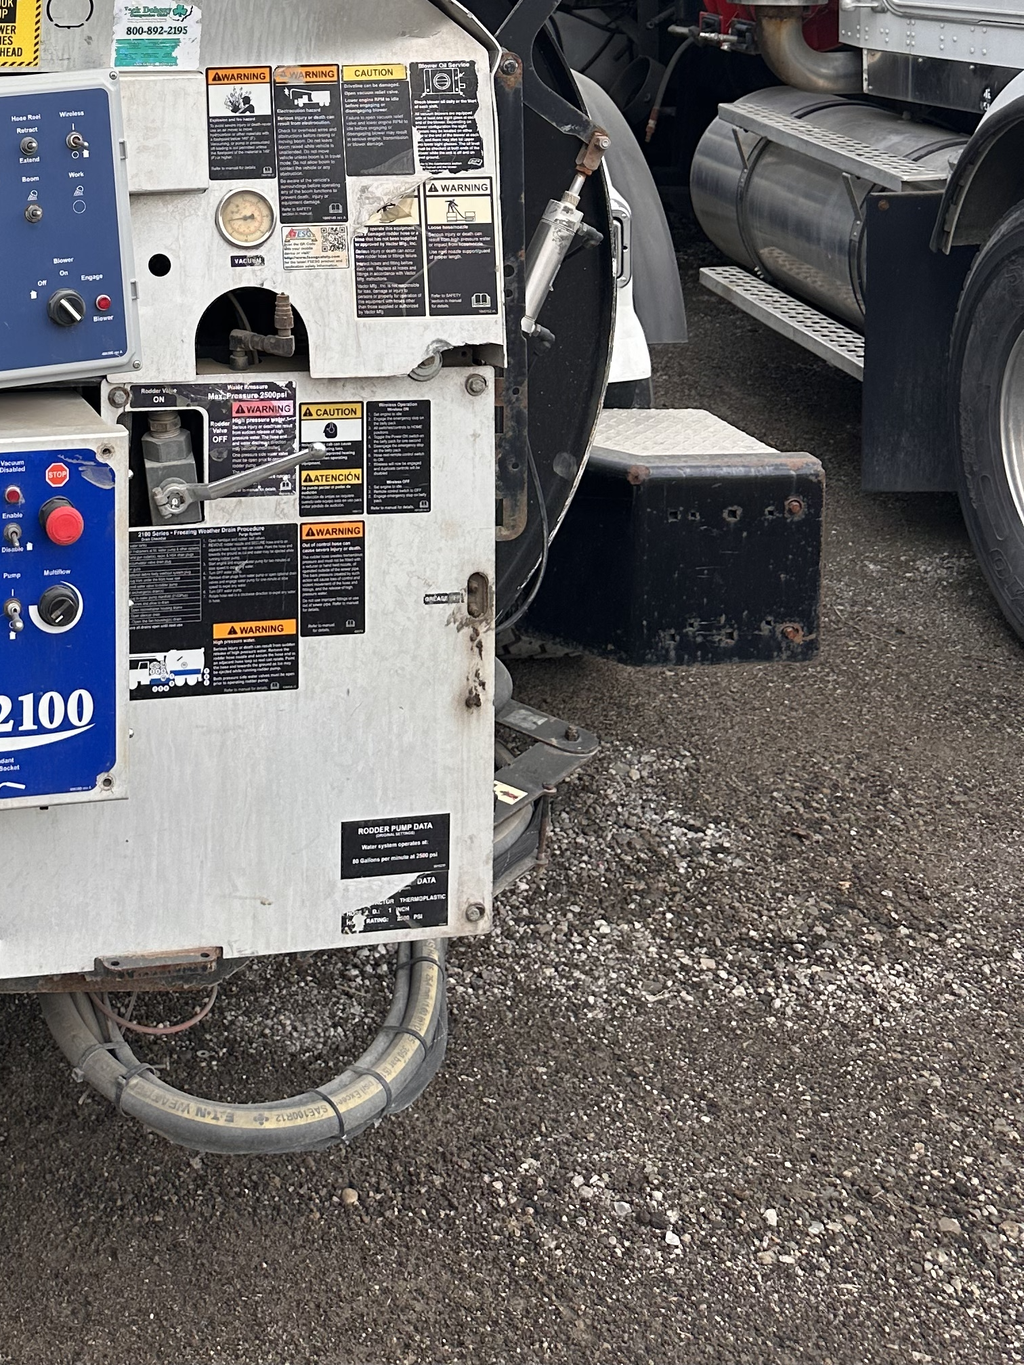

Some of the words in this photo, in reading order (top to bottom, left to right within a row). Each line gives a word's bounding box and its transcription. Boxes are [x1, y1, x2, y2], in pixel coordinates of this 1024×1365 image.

[126, 26, 187, 35] 800-892-2195
[221, 72, 266, 81] WARNING
[289, 71, 334, 79] WARNING
[354, 69, 393, 77] CAUTION
[440, 183, 488, 192] WARNING
[259, 391, 287, 399] 2500psi
[246, 405, 291, 413] WARNING
[316, 408, 357, 417] CAUTION
[313, 472, 360, 482] ATENCIÓN
[316, 527, 361, 537] WARNING
[239, 625, 284, 634] WARNING
[358, 825, 390, 835] RODDER
[413, 822, 433, 830] DATA
[417, 877, 436, 885] DATA
[399, 894, 446, 903] THERMOPLASTIC
